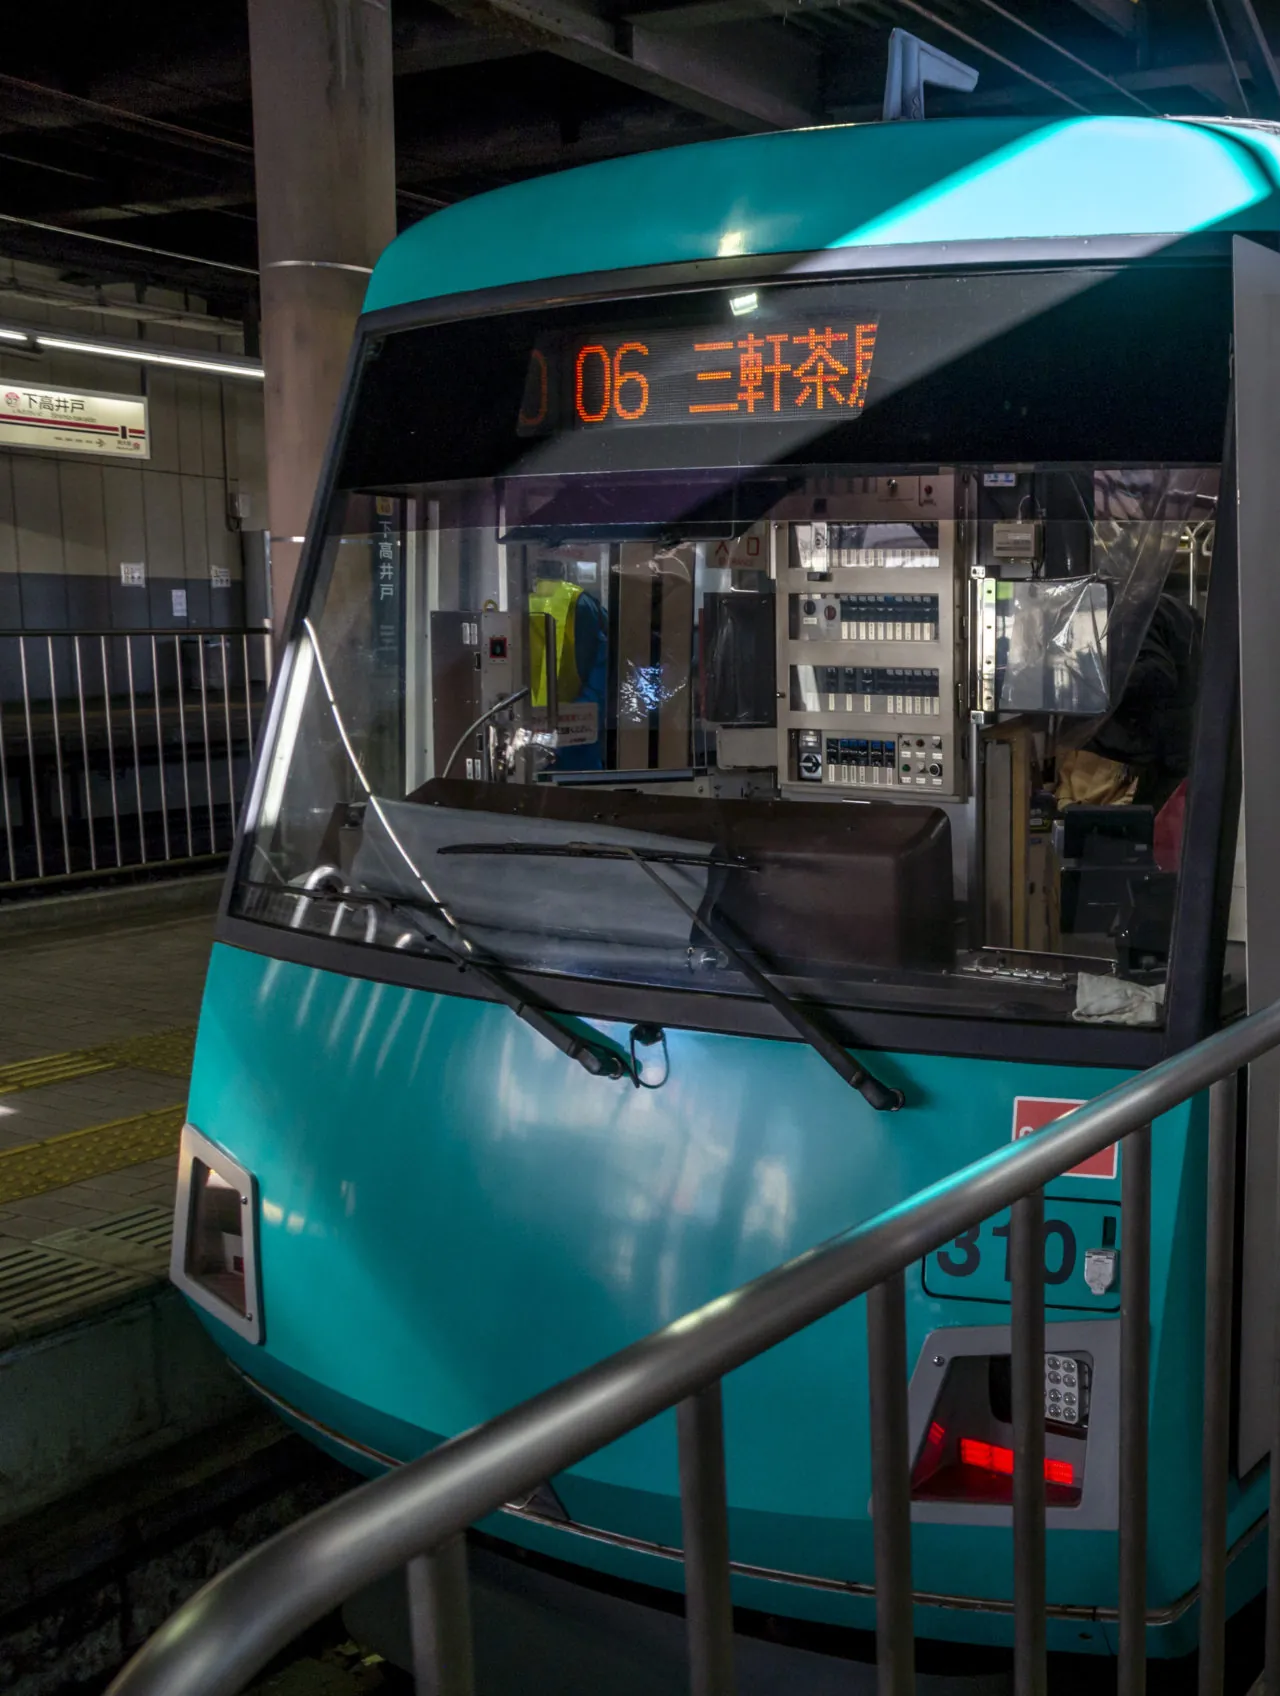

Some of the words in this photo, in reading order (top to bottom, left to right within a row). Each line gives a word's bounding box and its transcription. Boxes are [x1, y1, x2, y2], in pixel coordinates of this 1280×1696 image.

[22, 392, 85, 413] 下高井戸
[575, 341, 649, 423] 06
[378, 520, 395, 601] 下高井戸
